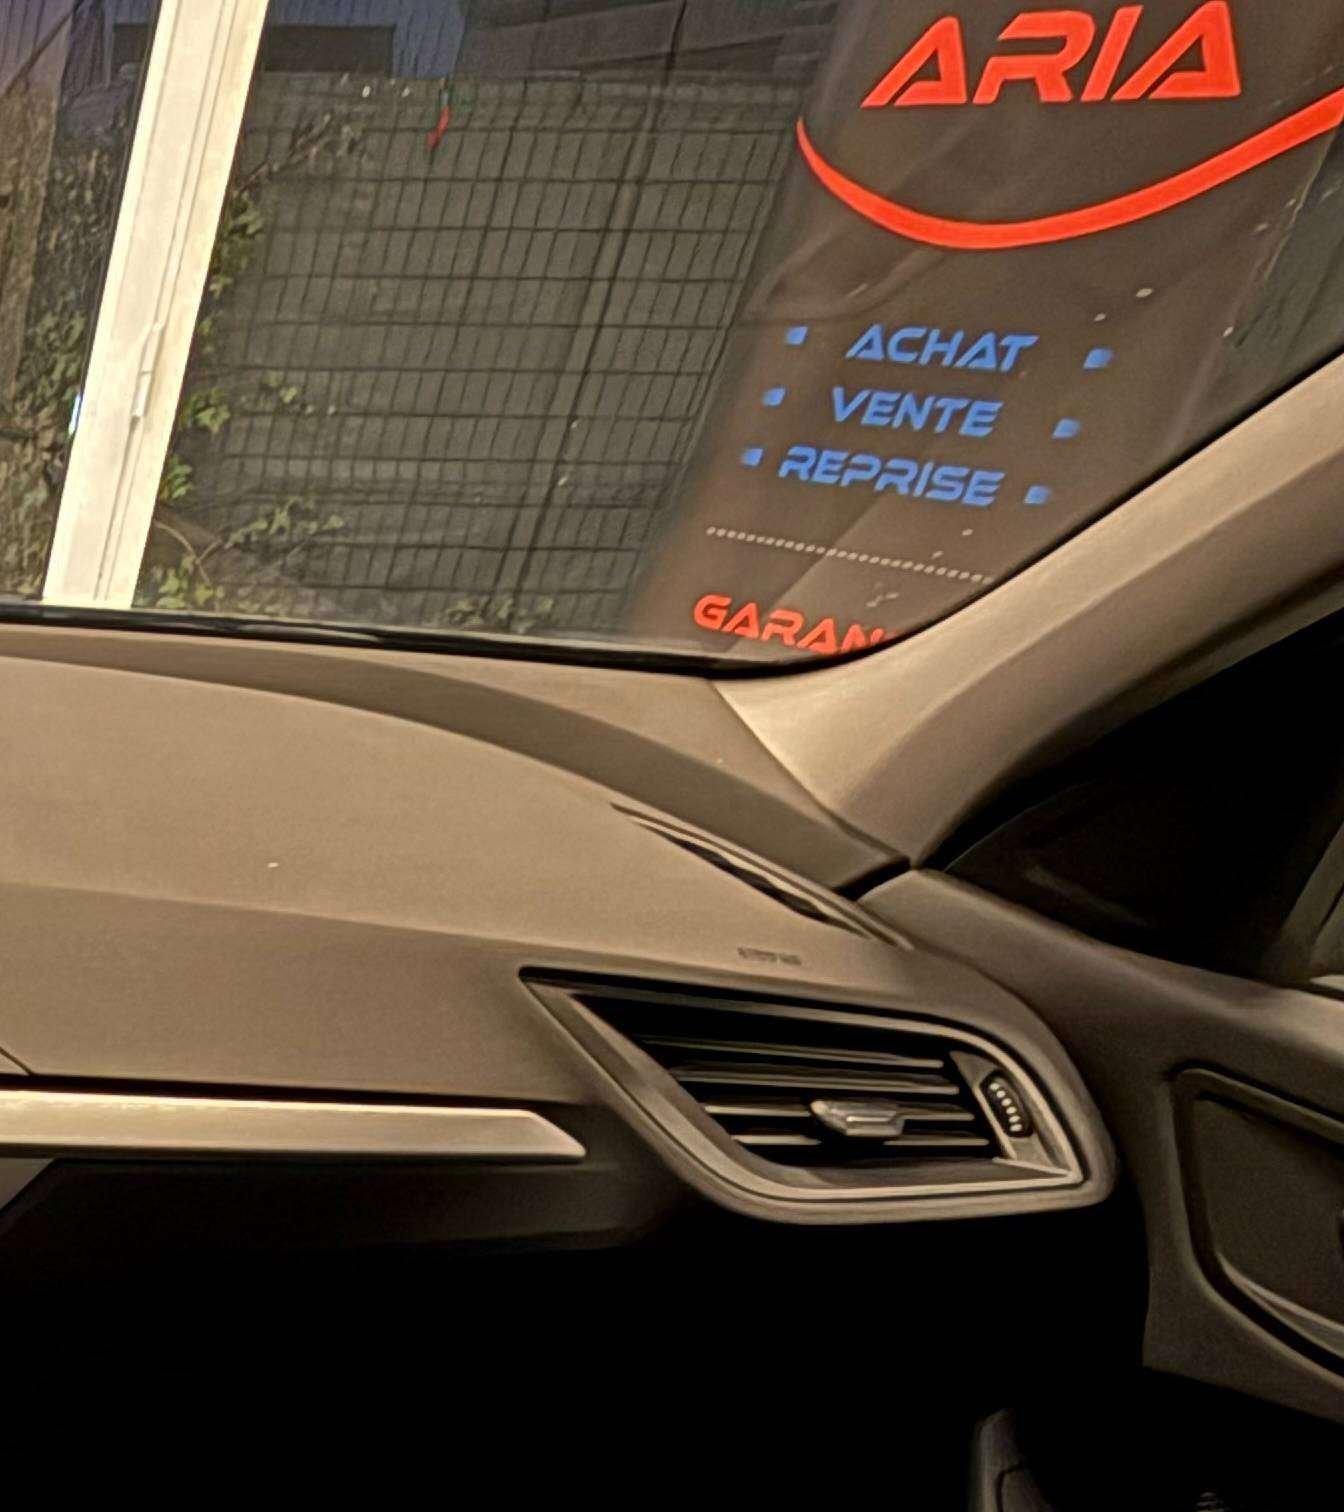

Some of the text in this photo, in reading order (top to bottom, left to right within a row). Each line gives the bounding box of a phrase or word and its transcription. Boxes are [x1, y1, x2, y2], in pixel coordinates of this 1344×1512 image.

[861, 0, 1241, 108] ARIA
[845, 323, 1039, 372] ACHAT
[832, 386, 1004, 437] VENTE
[777, 446, 1005, 507] REPRISE
